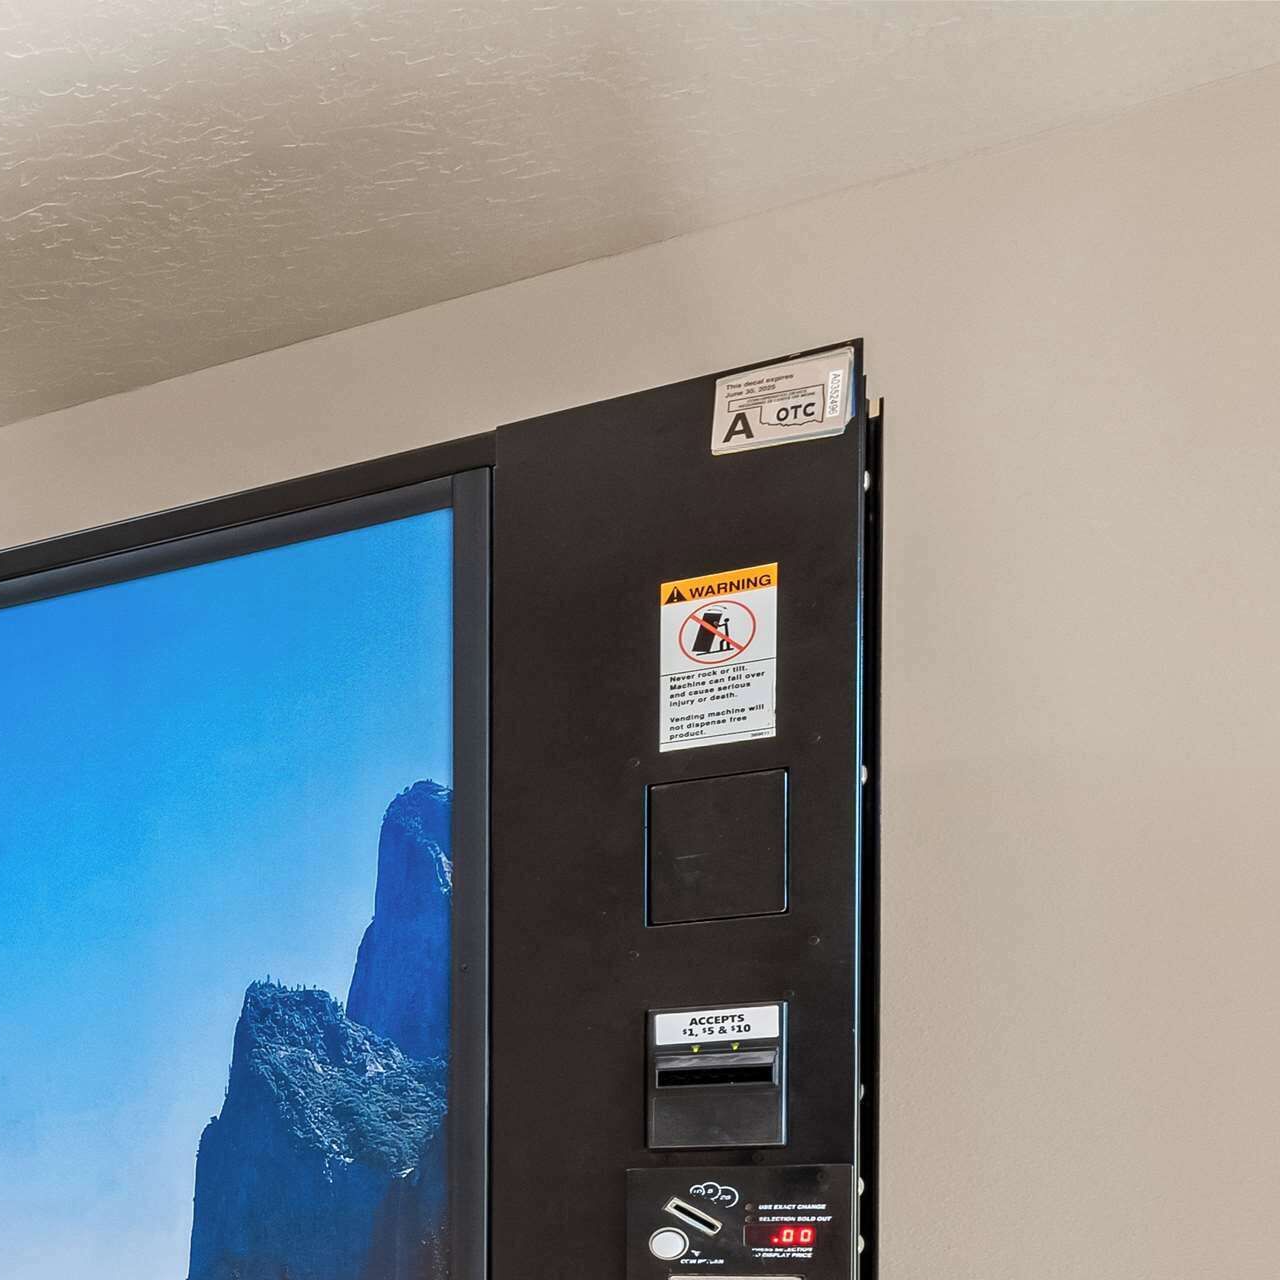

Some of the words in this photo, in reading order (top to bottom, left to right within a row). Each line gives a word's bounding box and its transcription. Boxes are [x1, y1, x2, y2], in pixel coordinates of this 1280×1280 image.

[726, 383, 742, 391] This
[743, 377, 765, 387] decal
[766, 373, 794, 384] expires
[724, 390, 743, 399] June
[776, 402, 816, 422] OTC
[722, 411, 755, 444] A
[689, 573, 772, 599] WARNING
[669, 673, 696, 683] Never
[698, 669, 718, 678] rock
[720, 667, 730, 675] or
[732, 665, 748, 673] tilt.
[669, 679, 706, 691] Machine
[708, 677, 725, 685] can
[727, 673, 742, 682] fall
[745, 670, 765, 679] over
[669, 690, 686, 699] and
[688, 687, 715, 696] cause
[717, 681, 751, 692] serious
[669, 698, 695, 708] injury
[709, 692, 738, 701] death.
[669, 713, 705, 723] Vending
[707, 707, 746, 717] machine
[748, 703, 765, 712] will
[669, 724, 684, 732] not
[686, 718, 727, 729] dispense
[729, 715, 747, 723] free
[669, 729, 706, 740] product.
[689, 1013, 745, 1026] ACCEPTS
[682, 1026, 699, 1037] $1,
[702, 1025, 715, 1036] $5
[718, 1025, 728, 1034] &
[731, 1023, 752, 1034] $10
